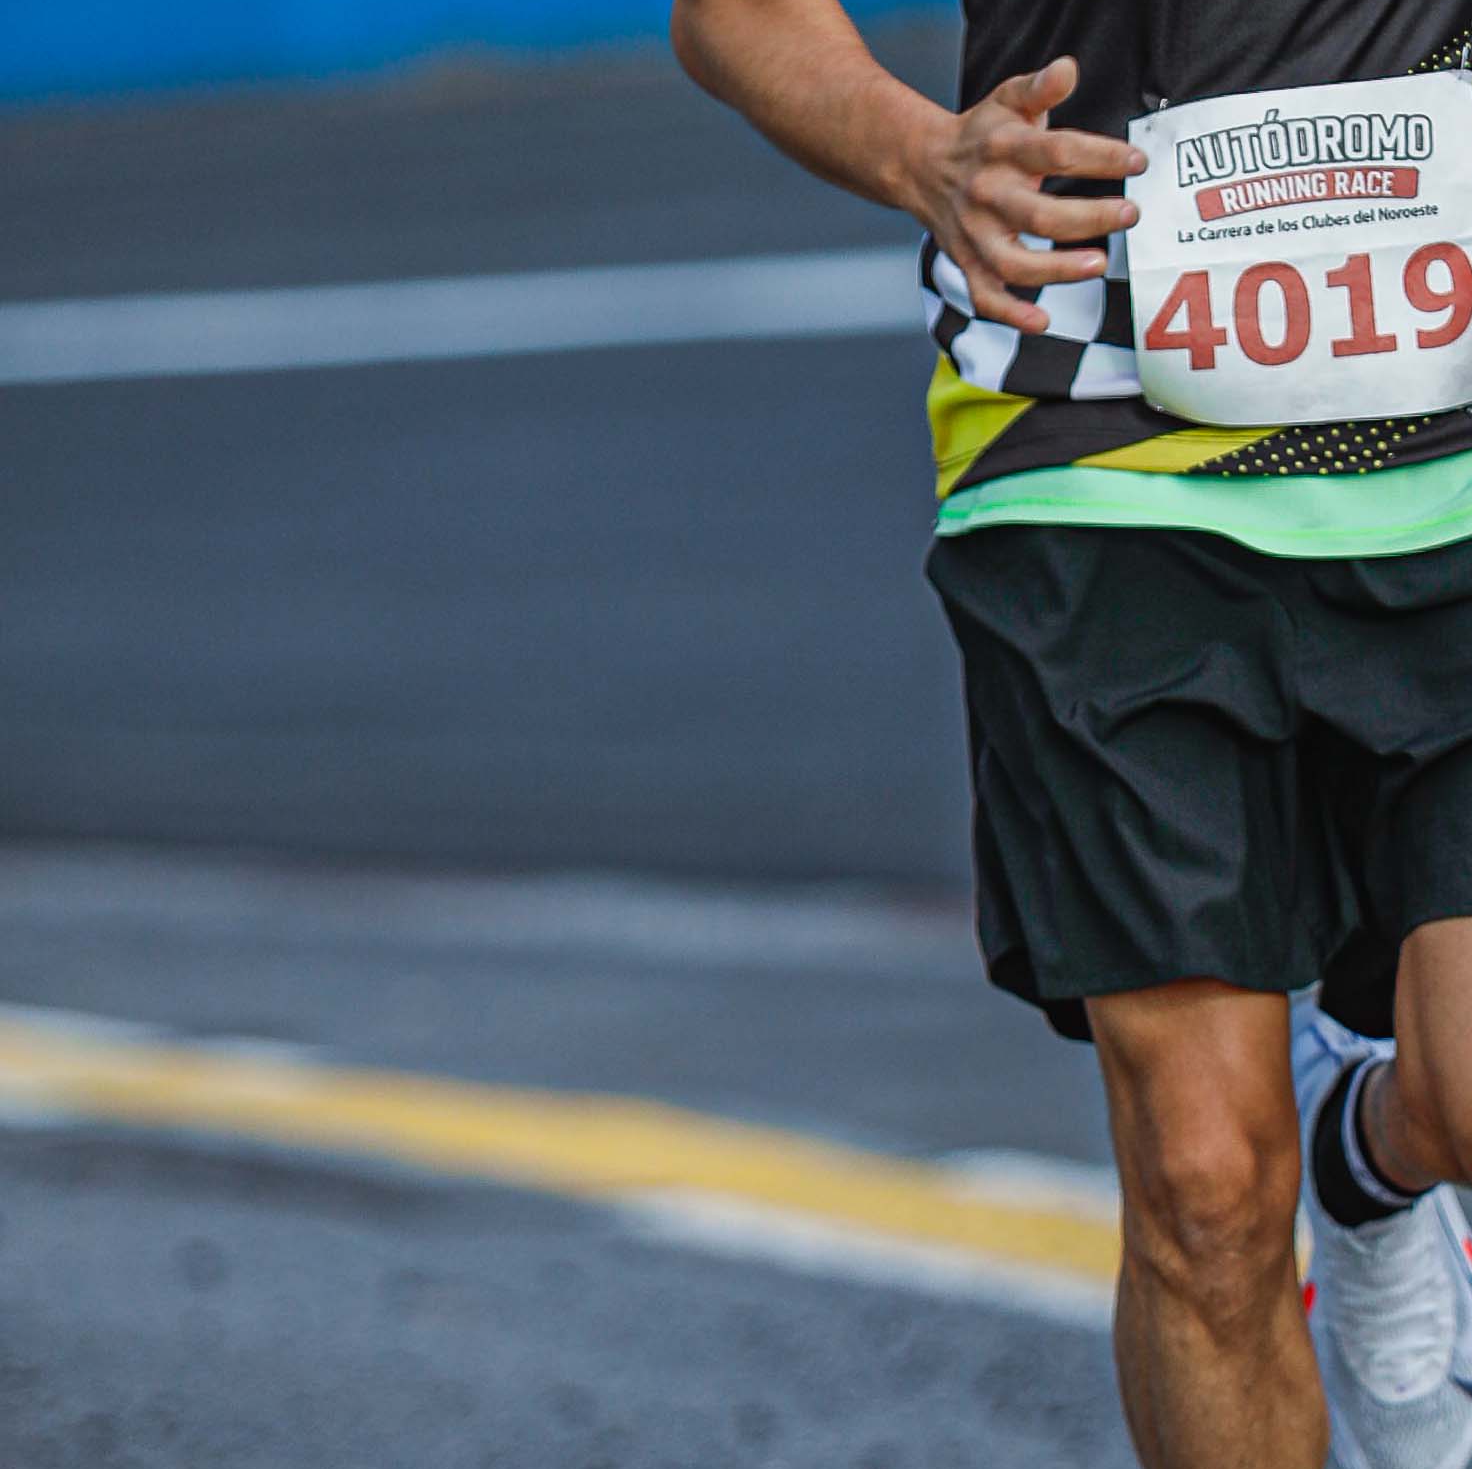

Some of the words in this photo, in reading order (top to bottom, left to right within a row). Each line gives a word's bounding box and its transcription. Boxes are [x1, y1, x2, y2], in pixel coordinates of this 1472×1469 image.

[1176, 109, 1433, 188] AUTÓDROMO
[1220, 171, 1327, 213] RUNNING
[1334, 170, 1396, 198] RACE
[1178, 230, 1194, 243] La
[1198, 225, 1252, 241] Carrera
[1255, 219, 1275, 235] de
[1278, 217, 1299, 232] los
[1302, 212, 1350, 230] Clubes
[1353, 210, 1376, 225] del
[1378, 204, 1439, 222] Noroeste
